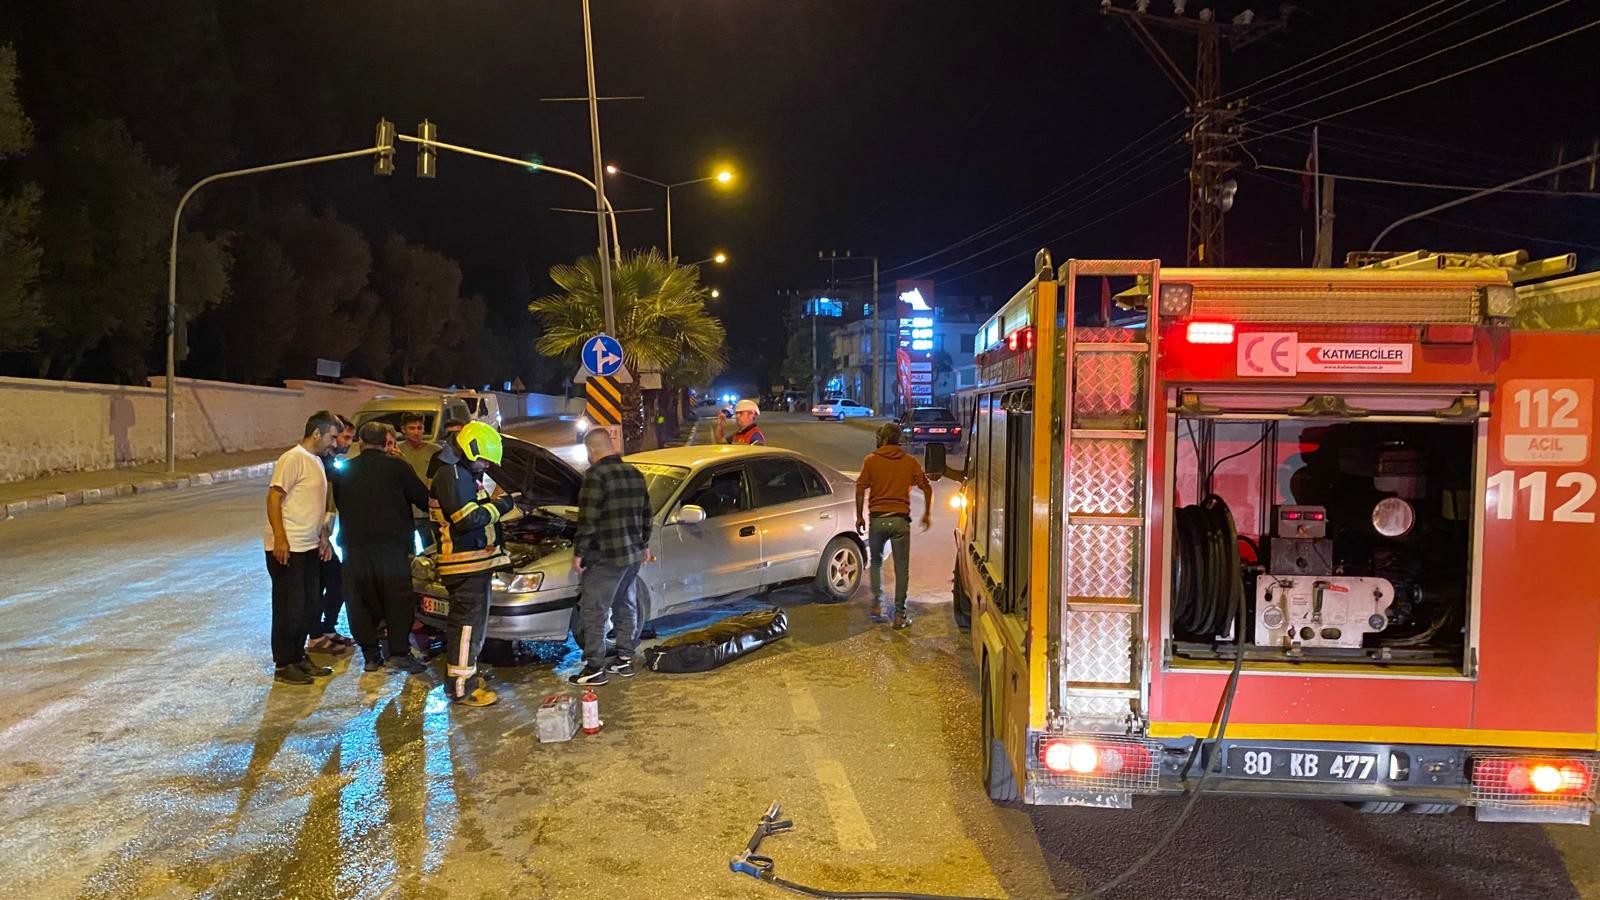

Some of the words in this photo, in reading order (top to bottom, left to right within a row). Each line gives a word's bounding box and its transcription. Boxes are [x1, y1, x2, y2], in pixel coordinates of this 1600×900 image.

[1322, 347, 1403, 360] KATMERCİLER
[1514, 388, 1579, 428] 112
[1528, 437, 1564, 451] ACİL
[1487, 470, 1597, 523] 112
[1244, 751, 1272, 775] 80
[1290, 752, 1319, 777] KB
[1329, 754, 1376, 780] 477
